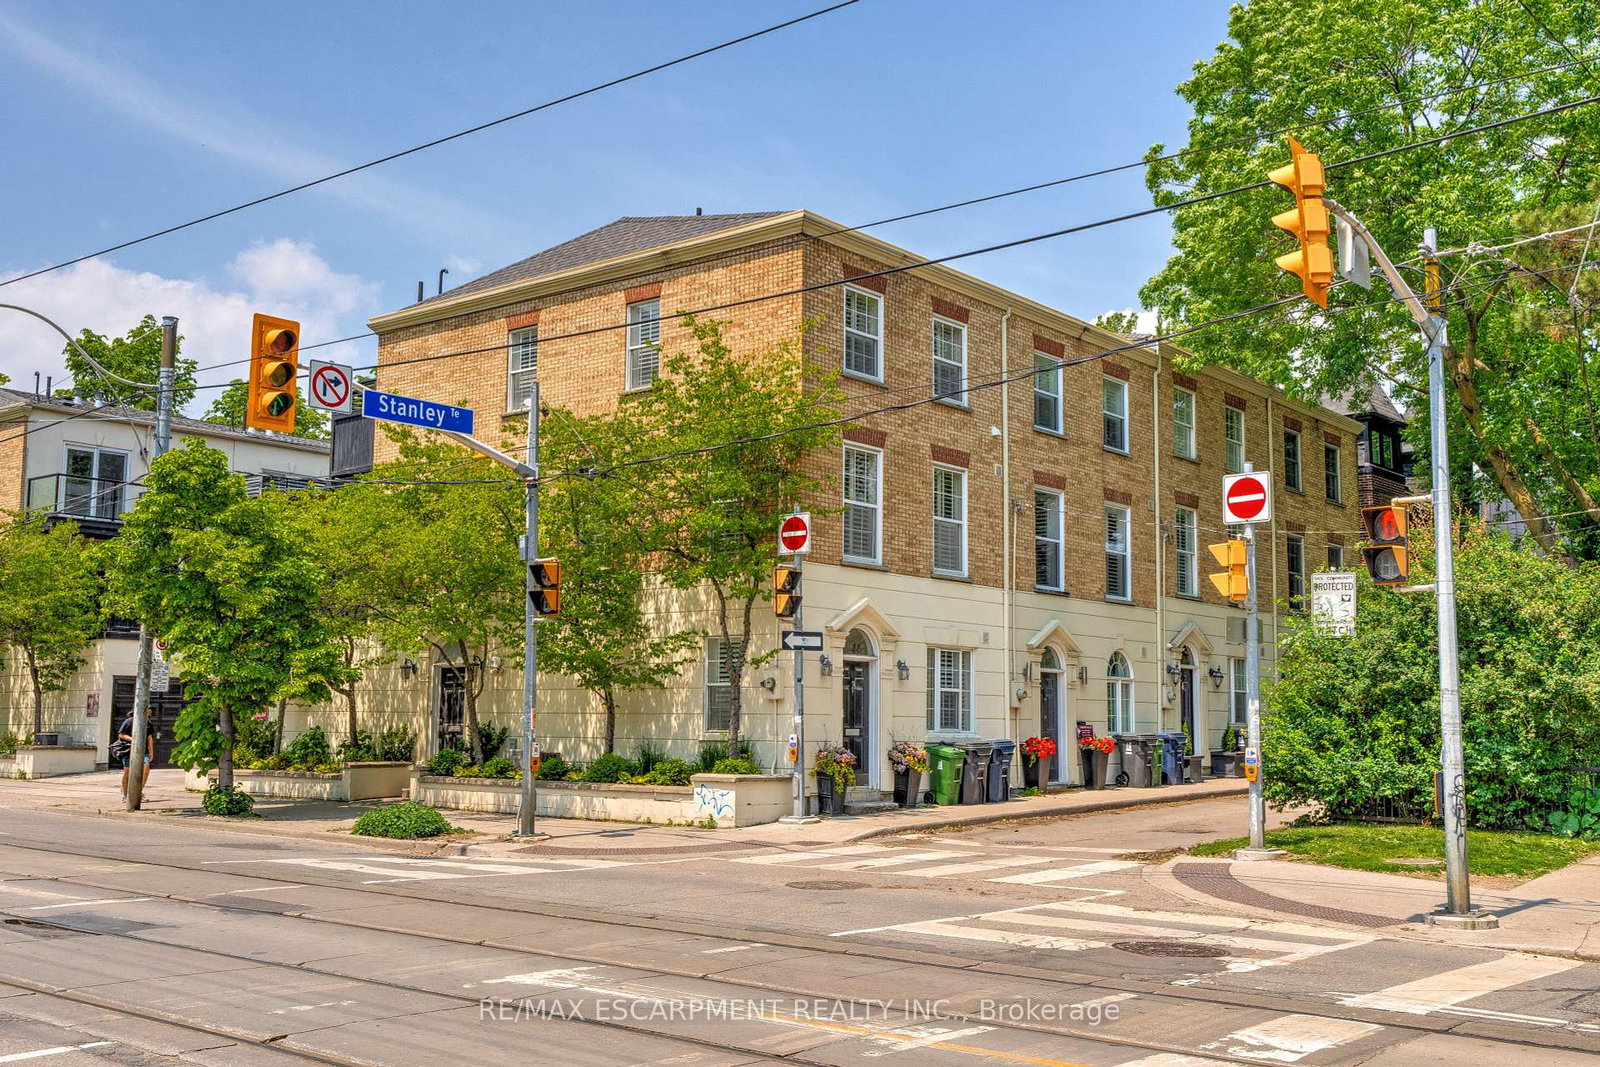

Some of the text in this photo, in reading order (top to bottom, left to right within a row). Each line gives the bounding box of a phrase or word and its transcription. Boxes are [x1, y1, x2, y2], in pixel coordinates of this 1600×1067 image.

[379, 395, 460, 427] Stanley Te
[1313, 582, 1354, 591] PROTECTED
